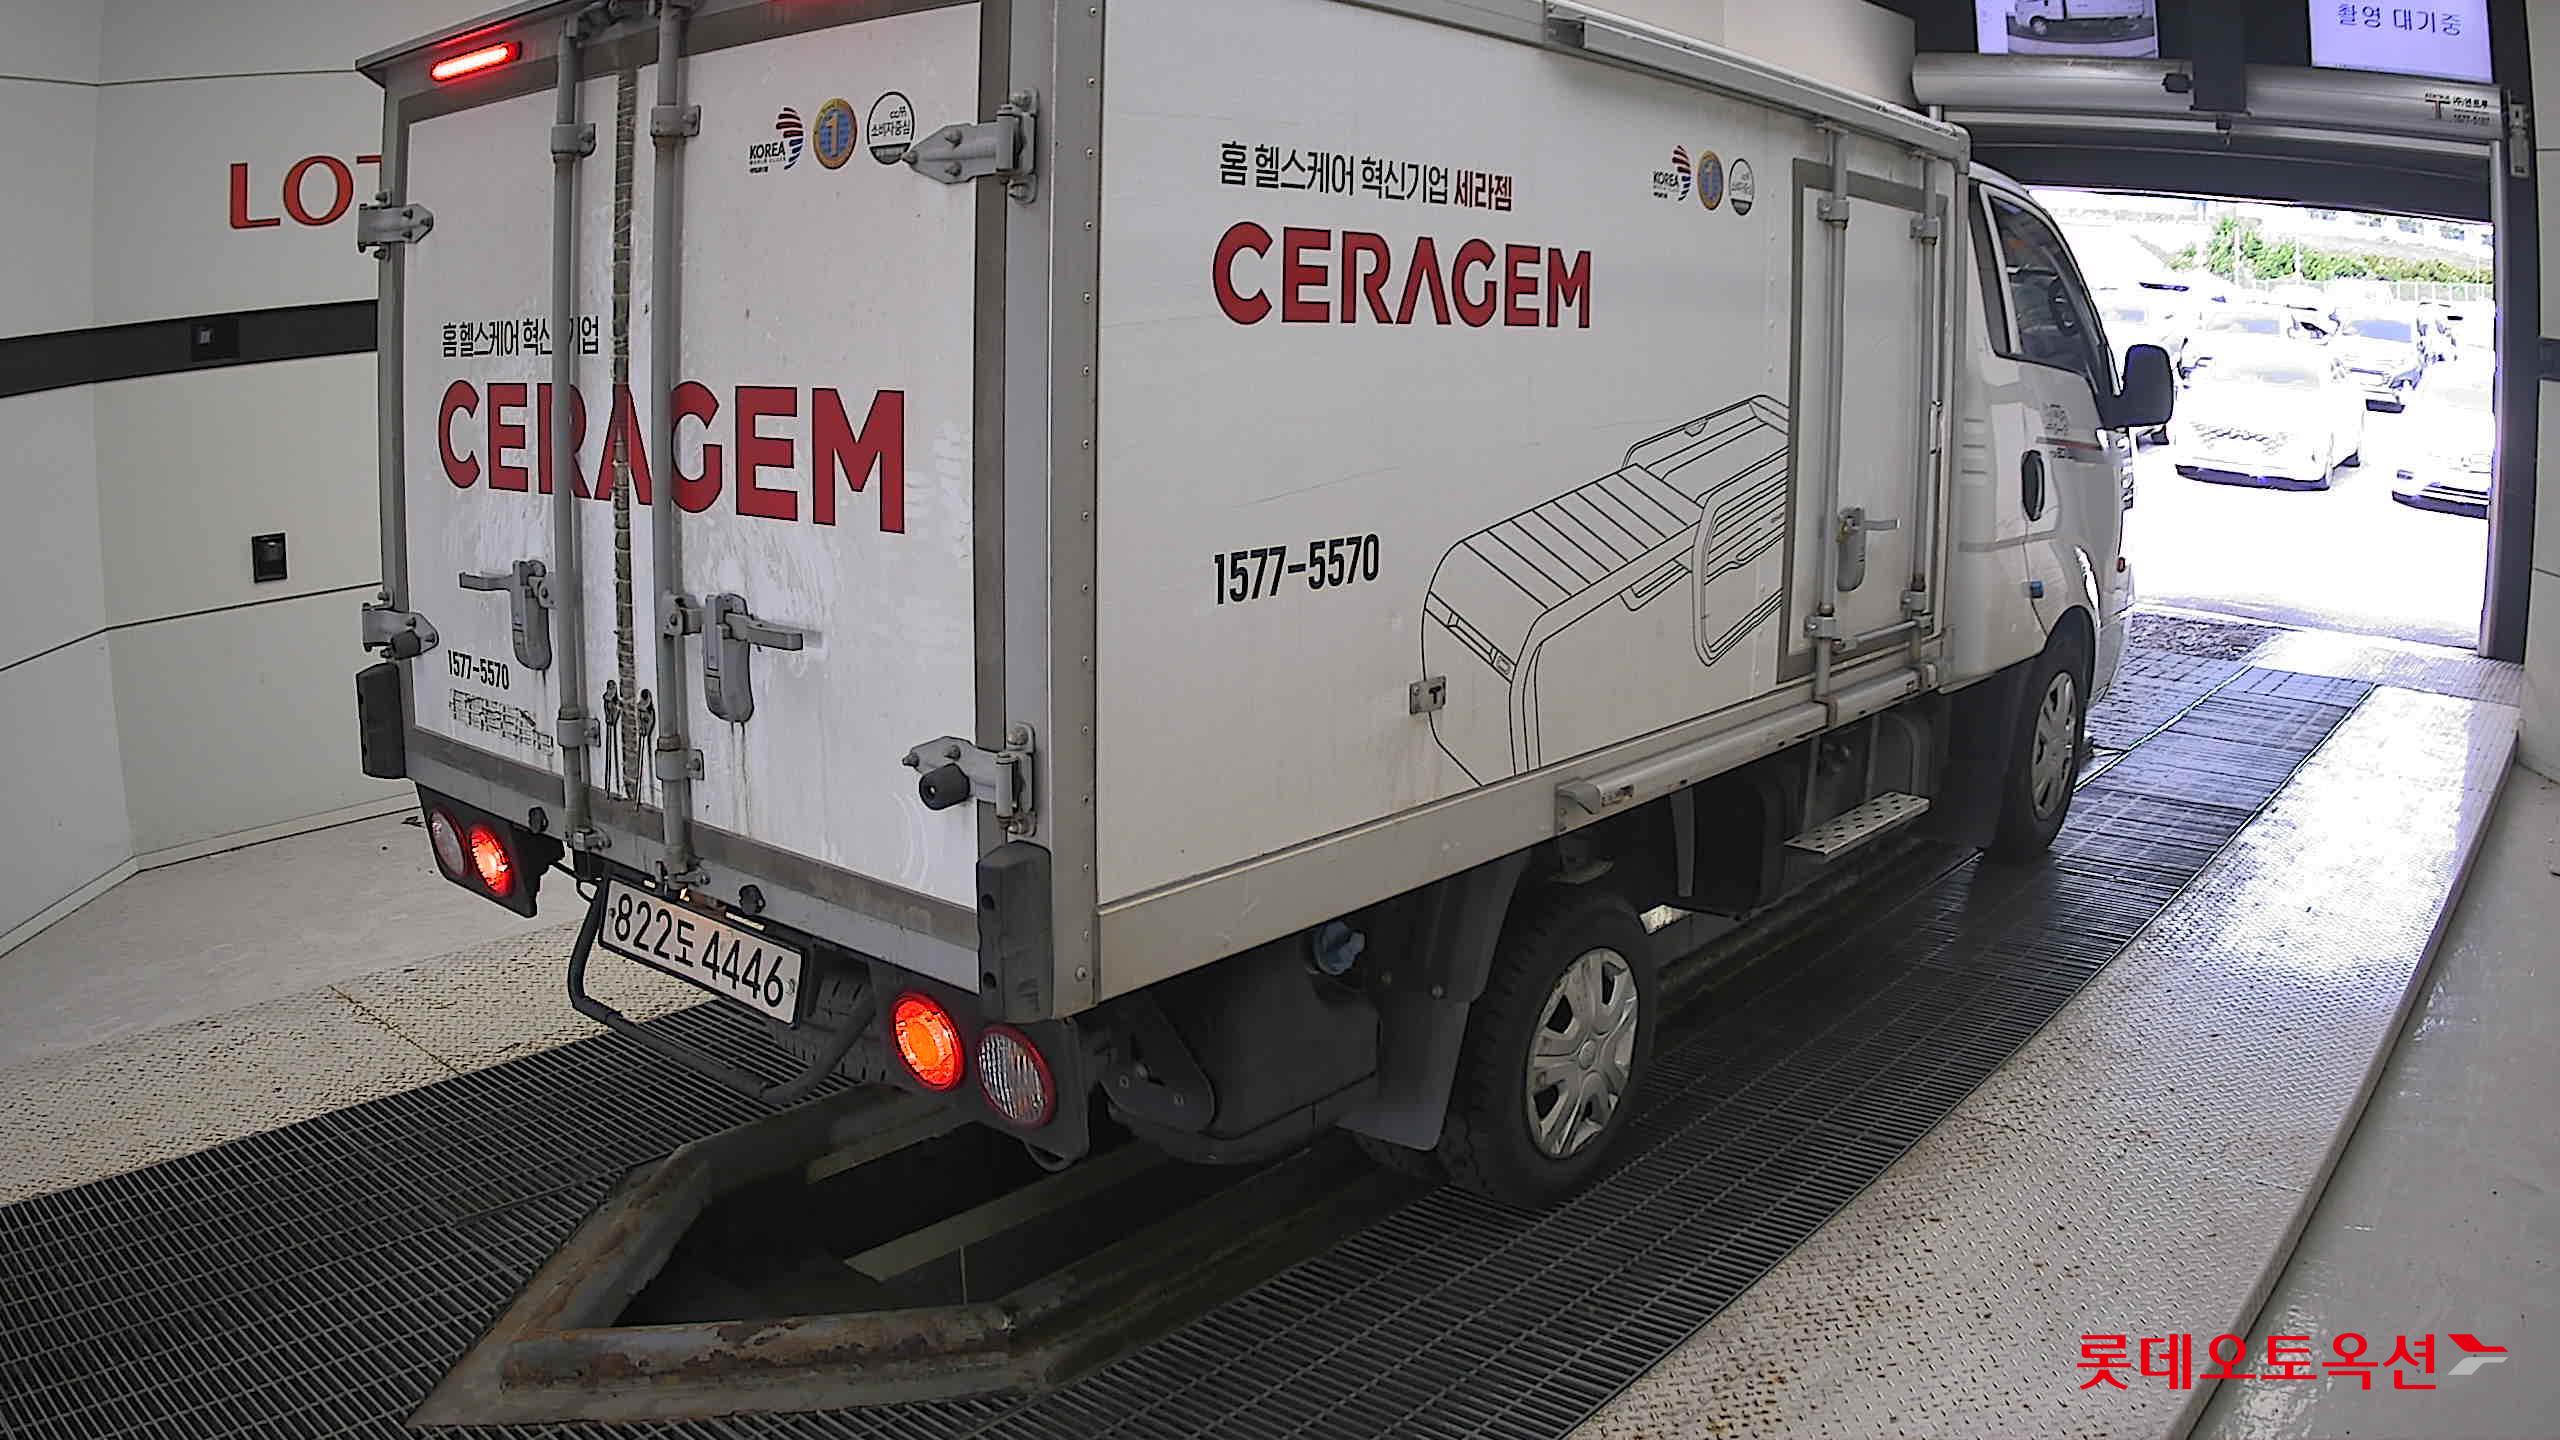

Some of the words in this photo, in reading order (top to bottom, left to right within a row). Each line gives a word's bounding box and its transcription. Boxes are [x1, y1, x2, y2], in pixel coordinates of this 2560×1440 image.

[2337, 3, 2382, 28] 촬영
[2392, 8, 2462, 36] 대기중
[749, 140, 786, 160] KOREA
[1219, 140, 1248, 187] 홈
[1254, 143, 1354, 197] 헬스케어
[1361, 155, 1449, 206] 혁신기업
[1453, 168, 1513, 212] 세라젬
[1653, 170, 1680, 188] KOREA
[1212, 220, 1592, 329] CERAGEM
[459, 319, 519, 358] 헬스케어
[438, 379, 906, 535] CERAGEM
[1213, 533, 1380, 606] 1577-5570
[446, 648, 511, 690] 1577-5570
[613, 892, 695, 968] 822도
[701, 930, 785, 1008] 4446
